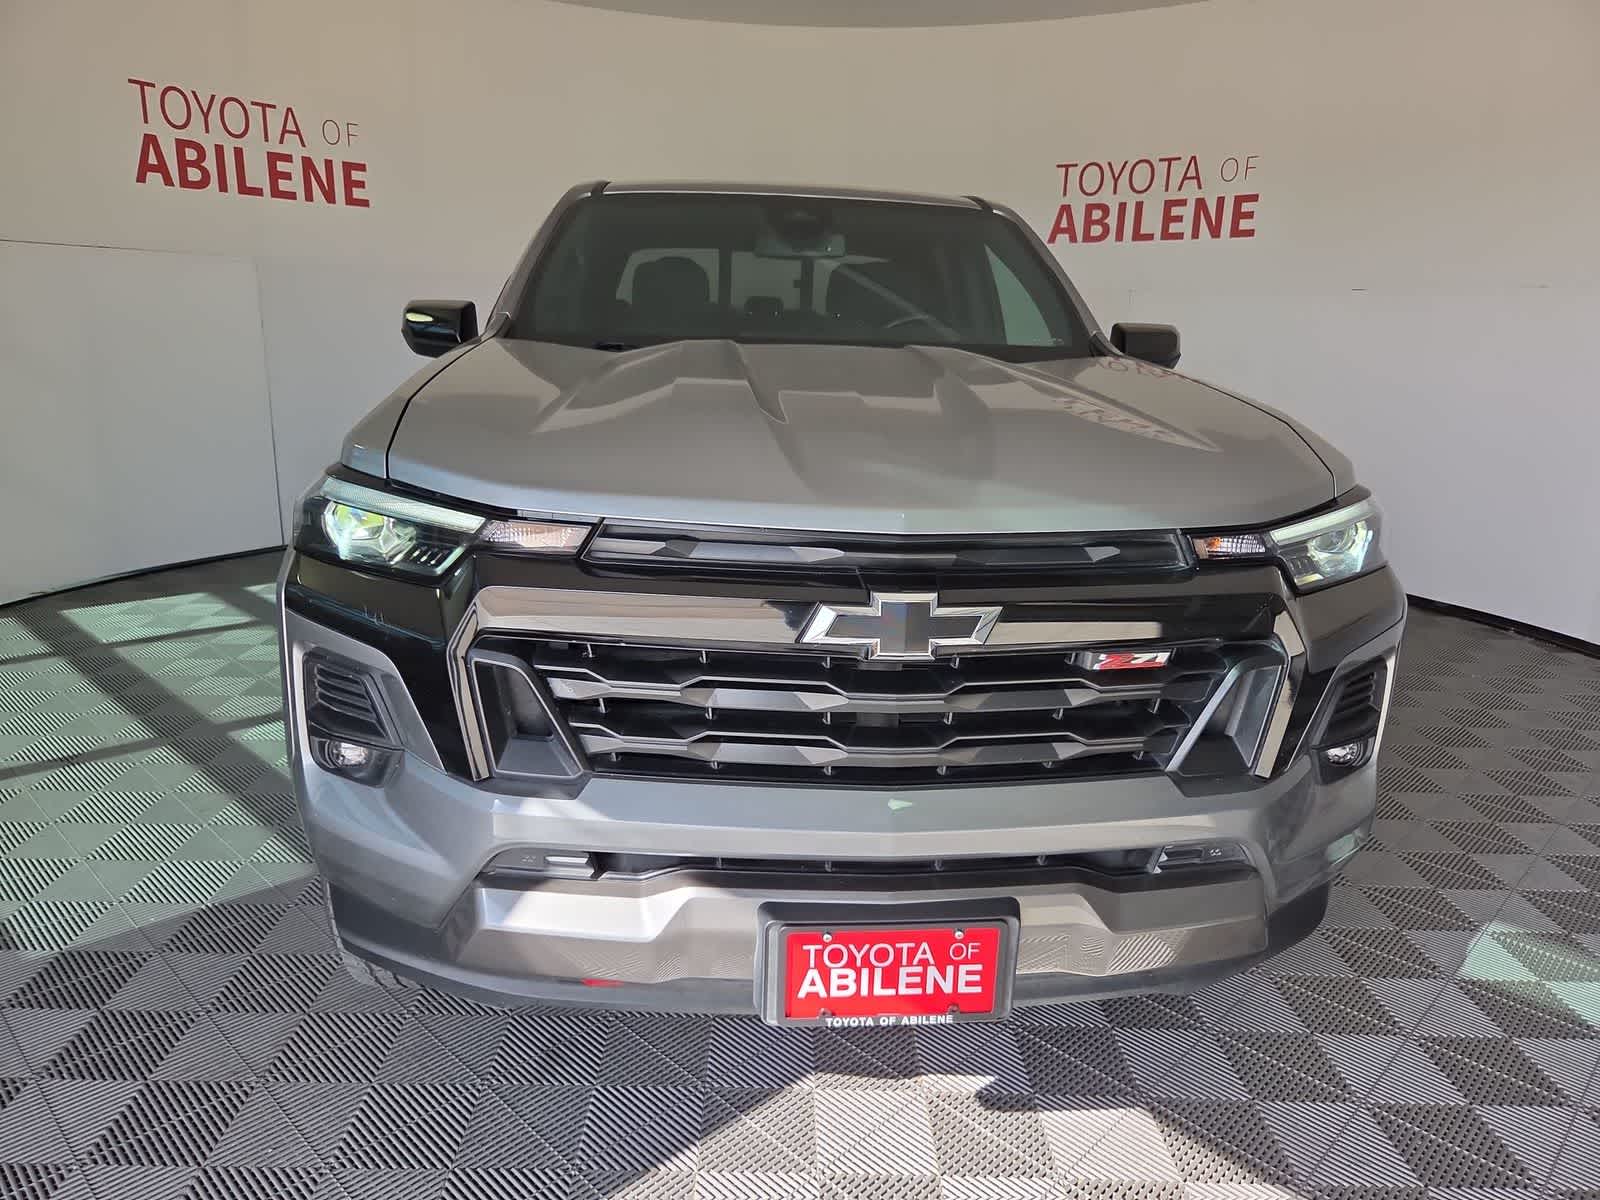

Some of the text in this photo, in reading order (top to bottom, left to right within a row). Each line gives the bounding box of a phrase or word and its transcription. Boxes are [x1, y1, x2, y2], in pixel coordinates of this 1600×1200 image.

[128, 78, 359, 148] TOYOTA OF
[135, 133, 370, 208] ABILENE
[1056, 155, 1260, 197] TOYOTA OF
[1047, 194, 1260, 244] ABILENE
[802, 942, 980, 969] TOYOTA OF
[797, 964, 983, 999] ABILENE
[825, 1015, 953, 1028] TOYOTA OF ABILENE
